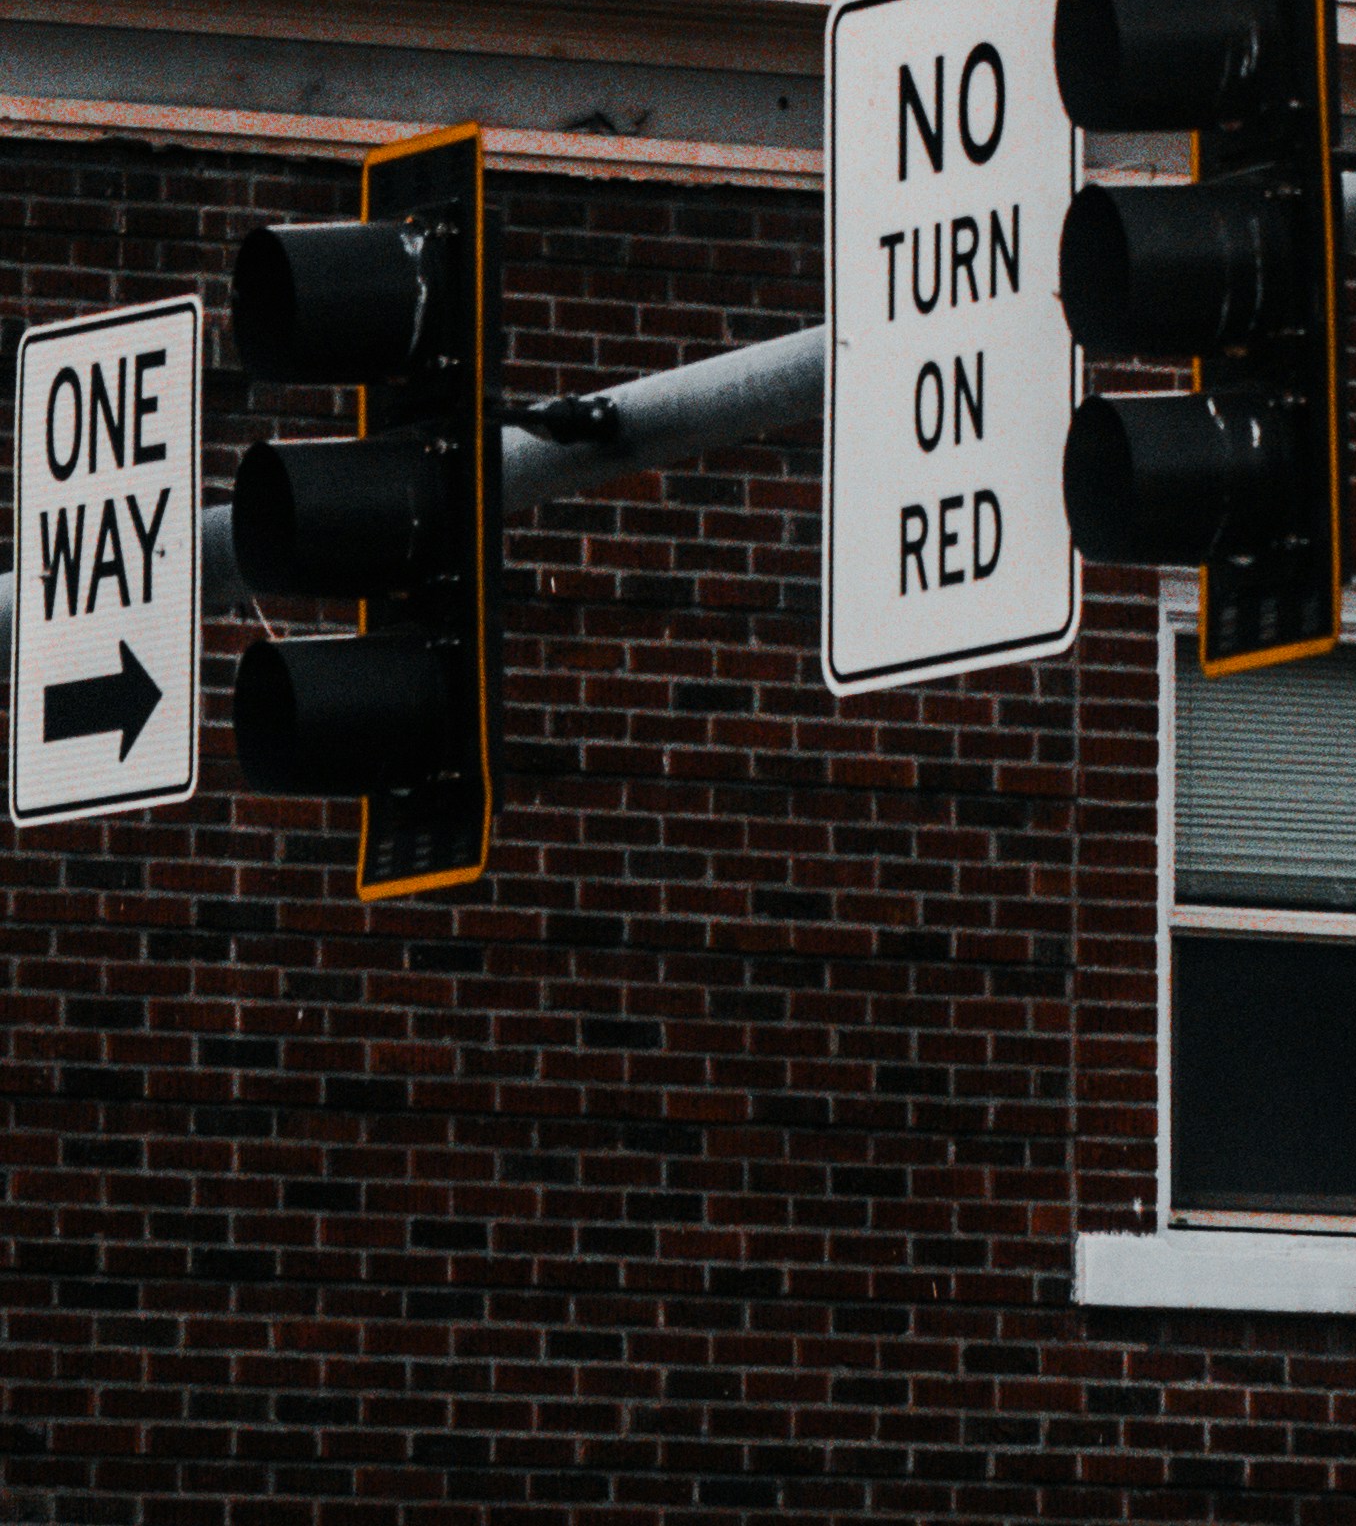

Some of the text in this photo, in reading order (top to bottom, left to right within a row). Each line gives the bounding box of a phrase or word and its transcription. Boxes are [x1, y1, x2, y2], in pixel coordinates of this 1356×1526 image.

[897, 40, 1007, 183] NO
[878, 203, 1022, 324] TURN
[44, 347, 168, 483] ONE
[912, 350, 986, 455] ON
[38, 486, 172, 622] WAY
[898, 487, 1005, 598] RED
